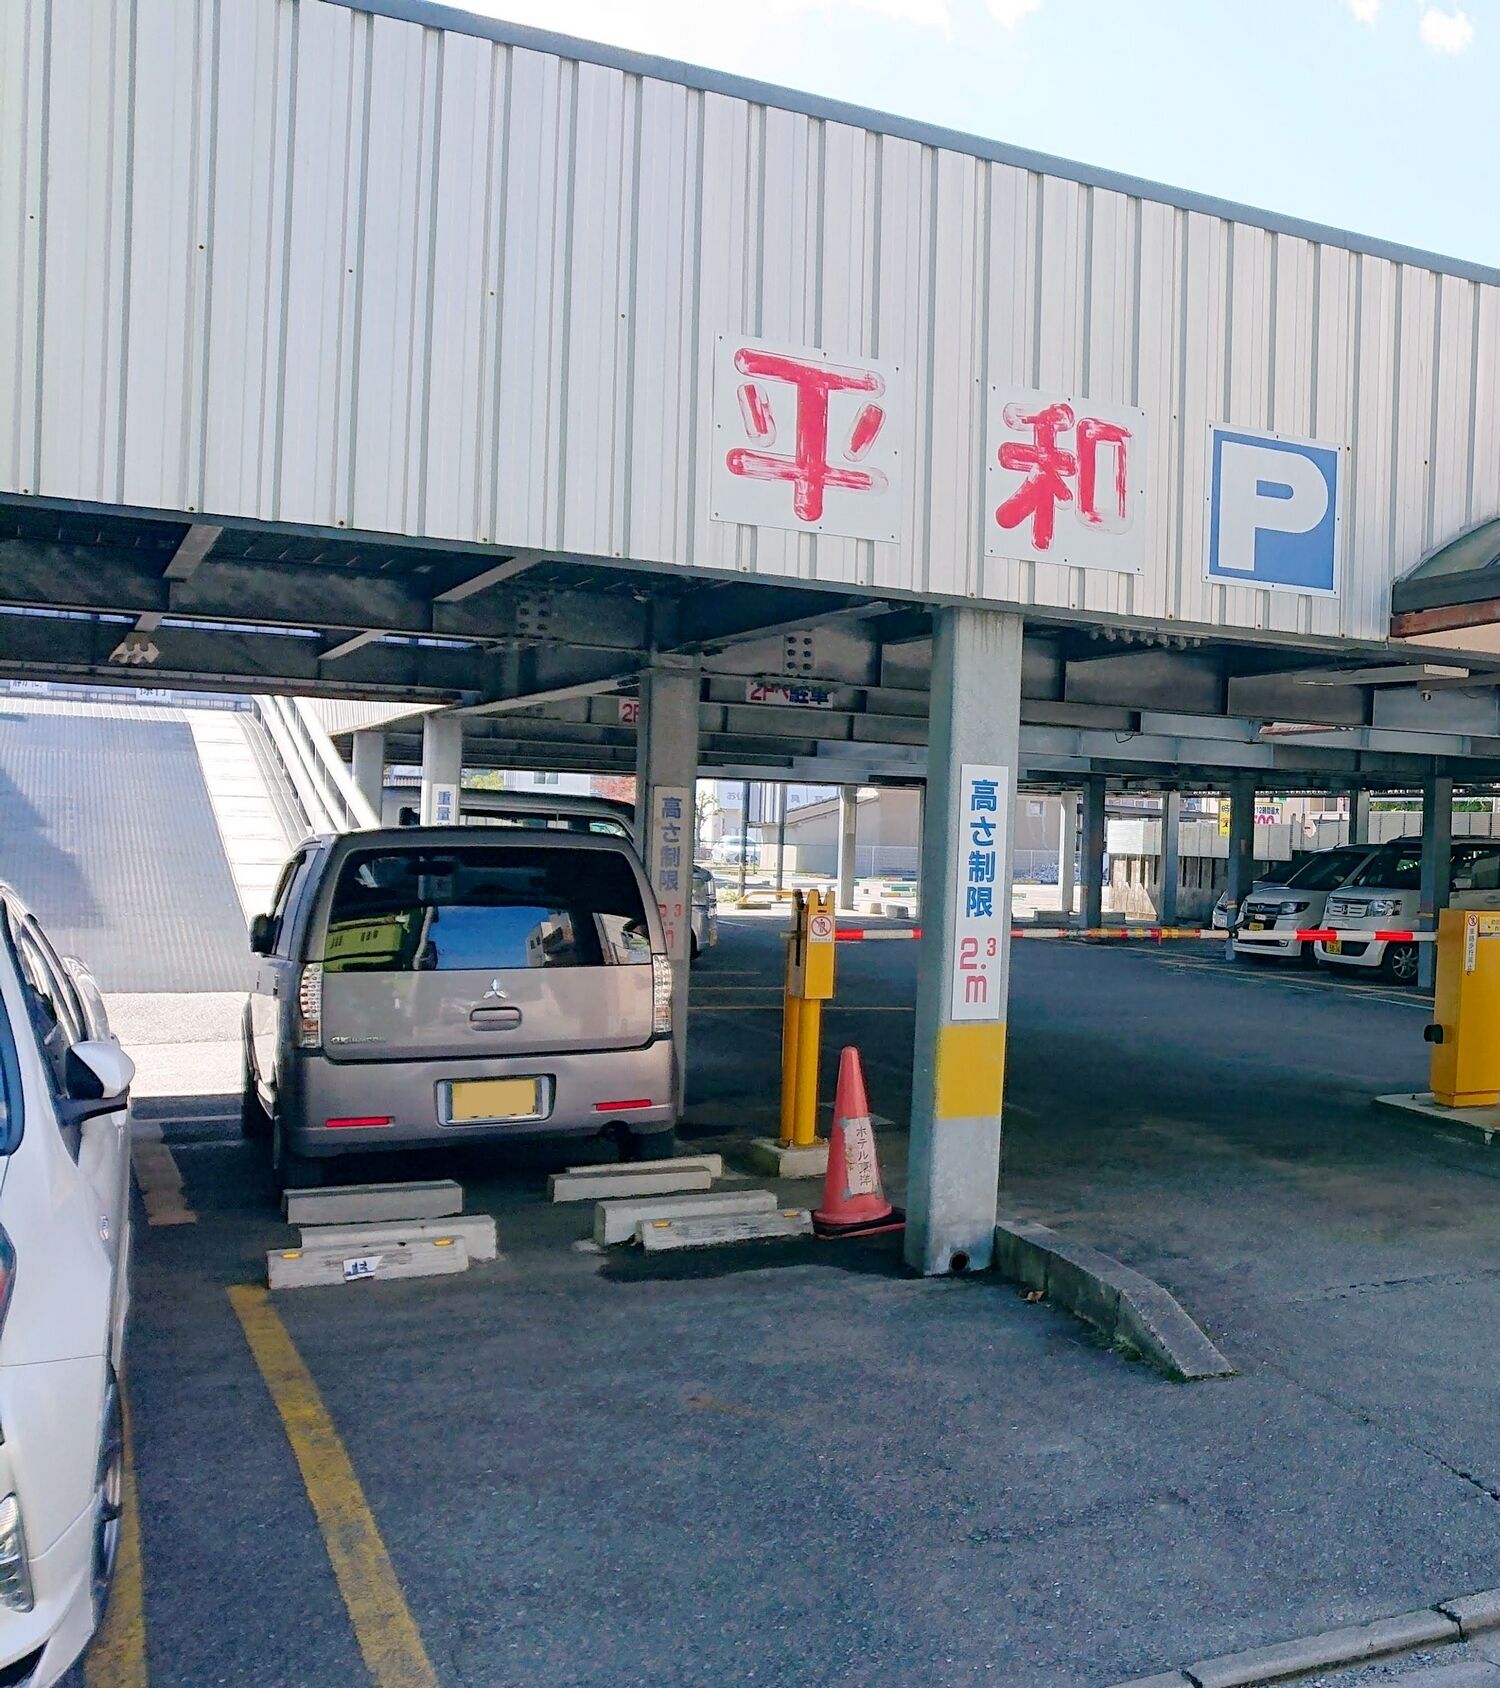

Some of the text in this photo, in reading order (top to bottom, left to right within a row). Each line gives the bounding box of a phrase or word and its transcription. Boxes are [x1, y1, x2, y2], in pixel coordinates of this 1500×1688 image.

[726, 348, 1329, 571] 平和 P
[659, 797, 683, 893] 高さ制限
[966, 779, 999, 918] 高さ制限
